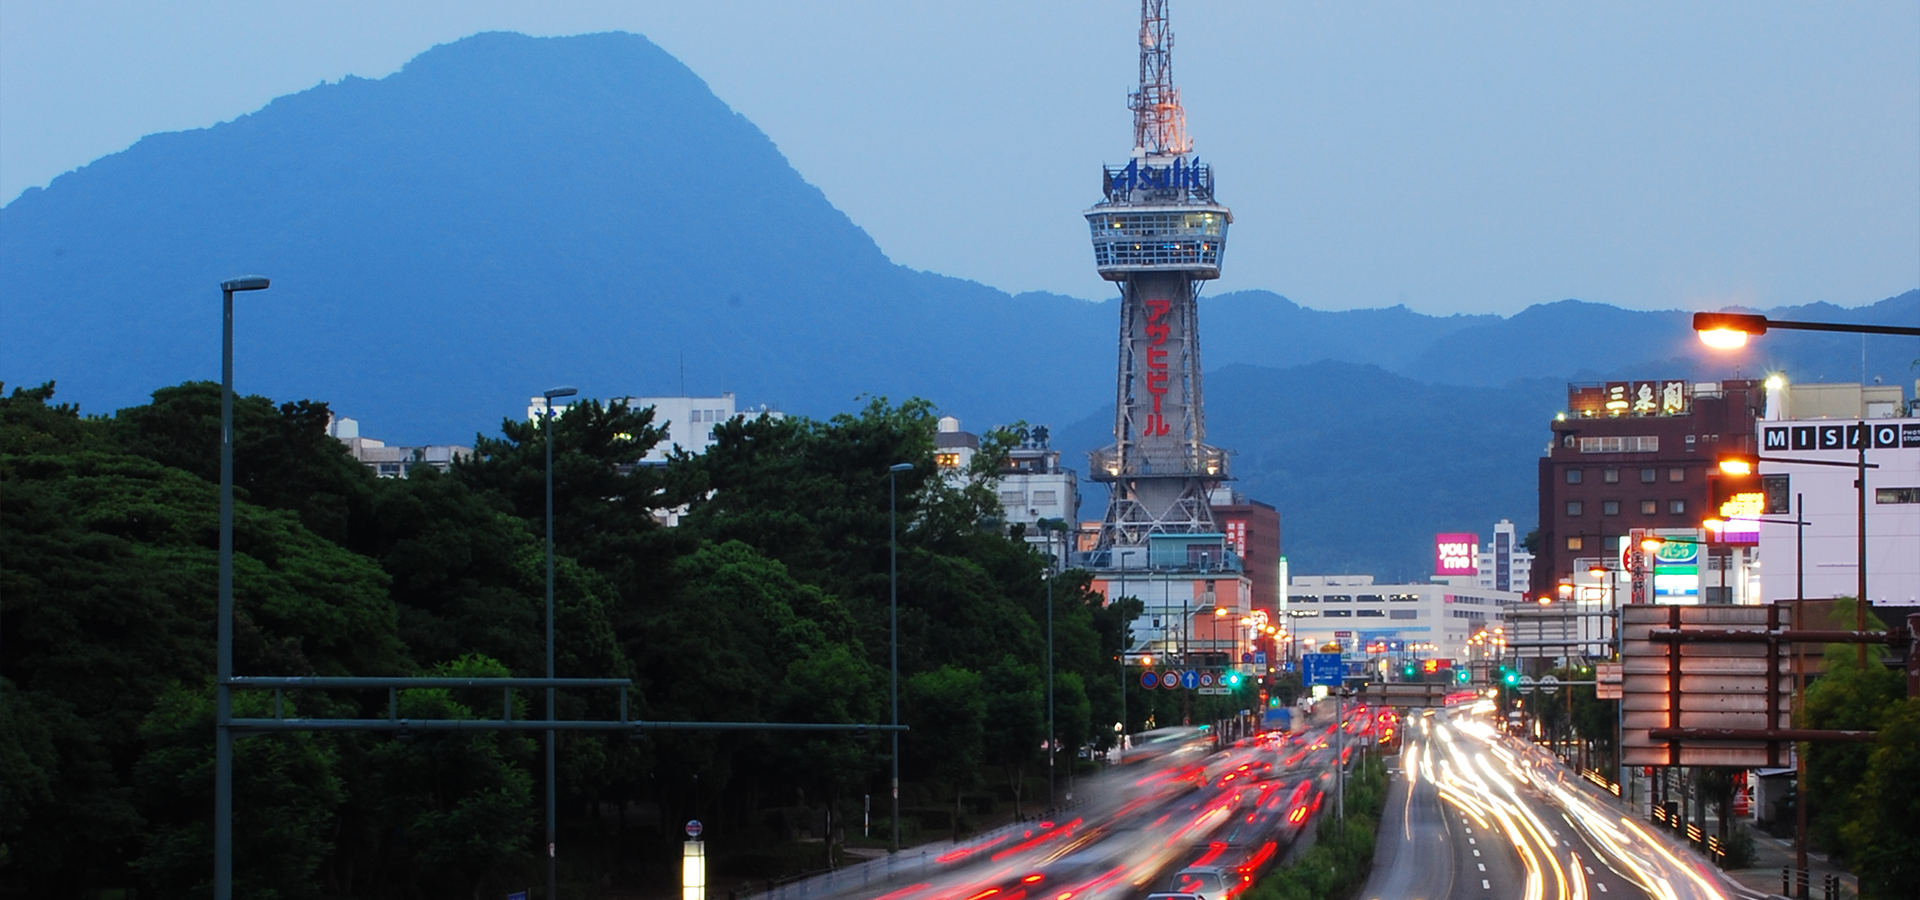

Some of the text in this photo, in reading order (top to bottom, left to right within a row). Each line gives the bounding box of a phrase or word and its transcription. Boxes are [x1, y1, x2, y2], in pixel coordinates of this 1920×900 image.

[1112, 156, 1200, 190] Asahi
[1145, 299, 1170, 437] アサヒビール
[1438, 543, 1468, 560] you
[1444, 556, 1470, 569] me
